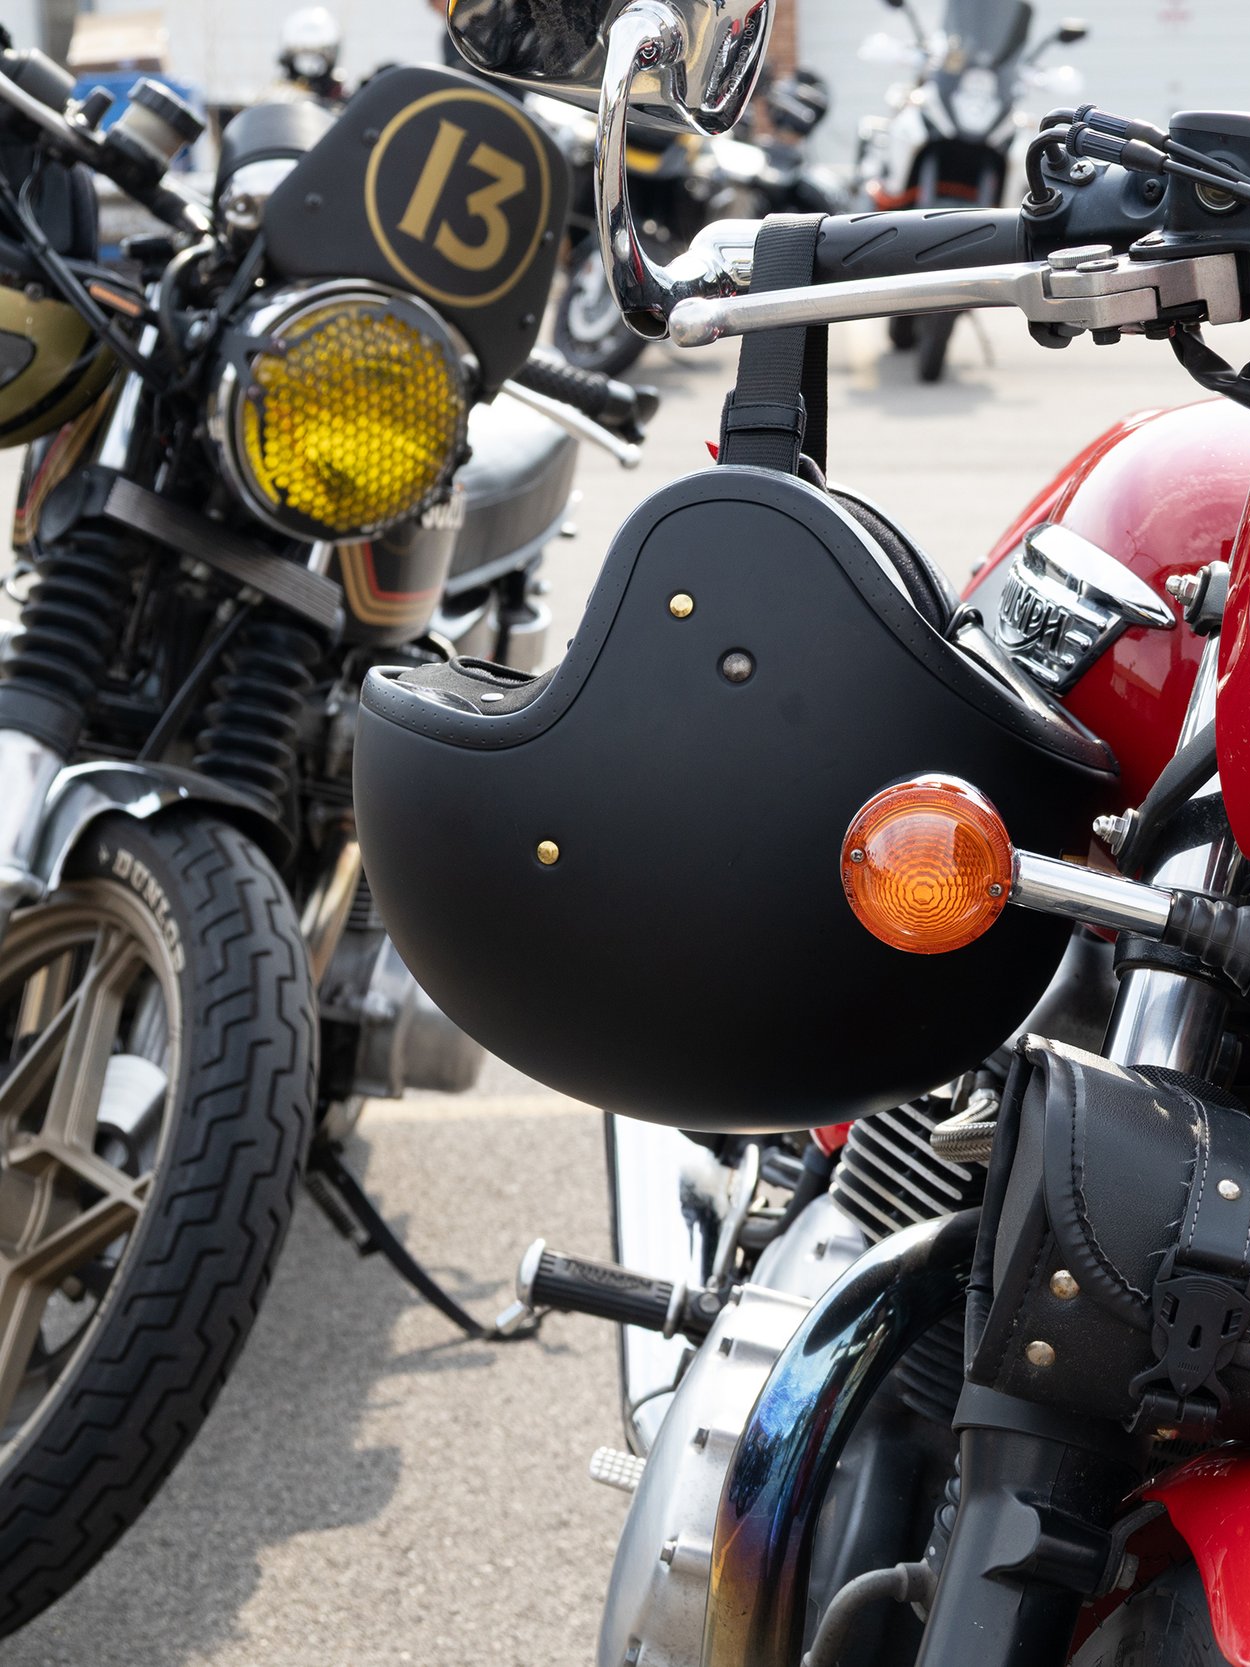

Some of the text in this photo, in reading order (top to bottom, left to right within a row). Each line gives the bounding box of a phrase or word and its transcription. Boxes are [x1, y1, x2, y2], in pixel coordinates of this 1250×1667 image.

[397, 117, 527, 273] 13
[1000, 576, 1070, 657] UMPH
[111, 847, 187, 974] DUNLOP
